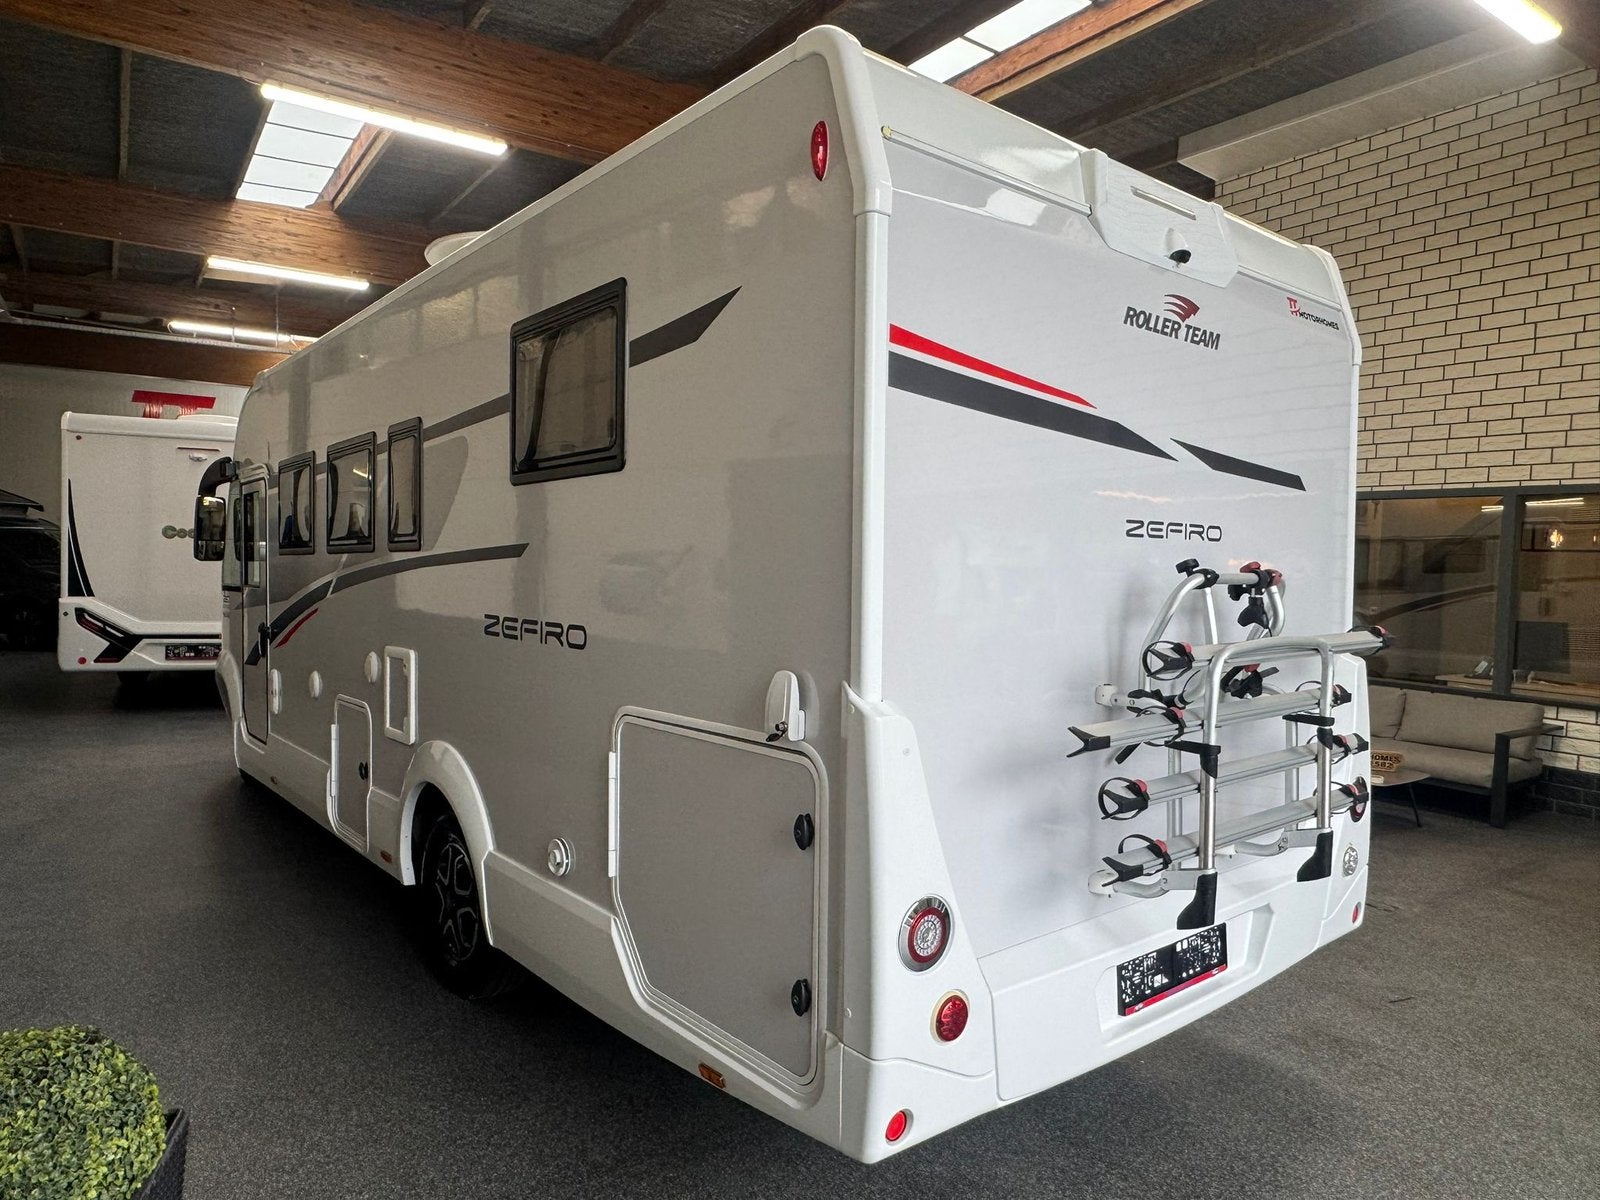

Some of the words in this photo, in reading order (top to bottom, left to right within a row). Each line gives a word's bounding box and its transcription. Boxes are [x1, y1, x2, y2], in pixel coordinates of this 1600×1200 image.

[1123, 306, 1182, 340] ROLLER
[1183, 323, 1221, 351] TEAM
[1125, 519, 1222, 542] ZEFIRO
[484, 613, 587, 650] ZEFIRO
